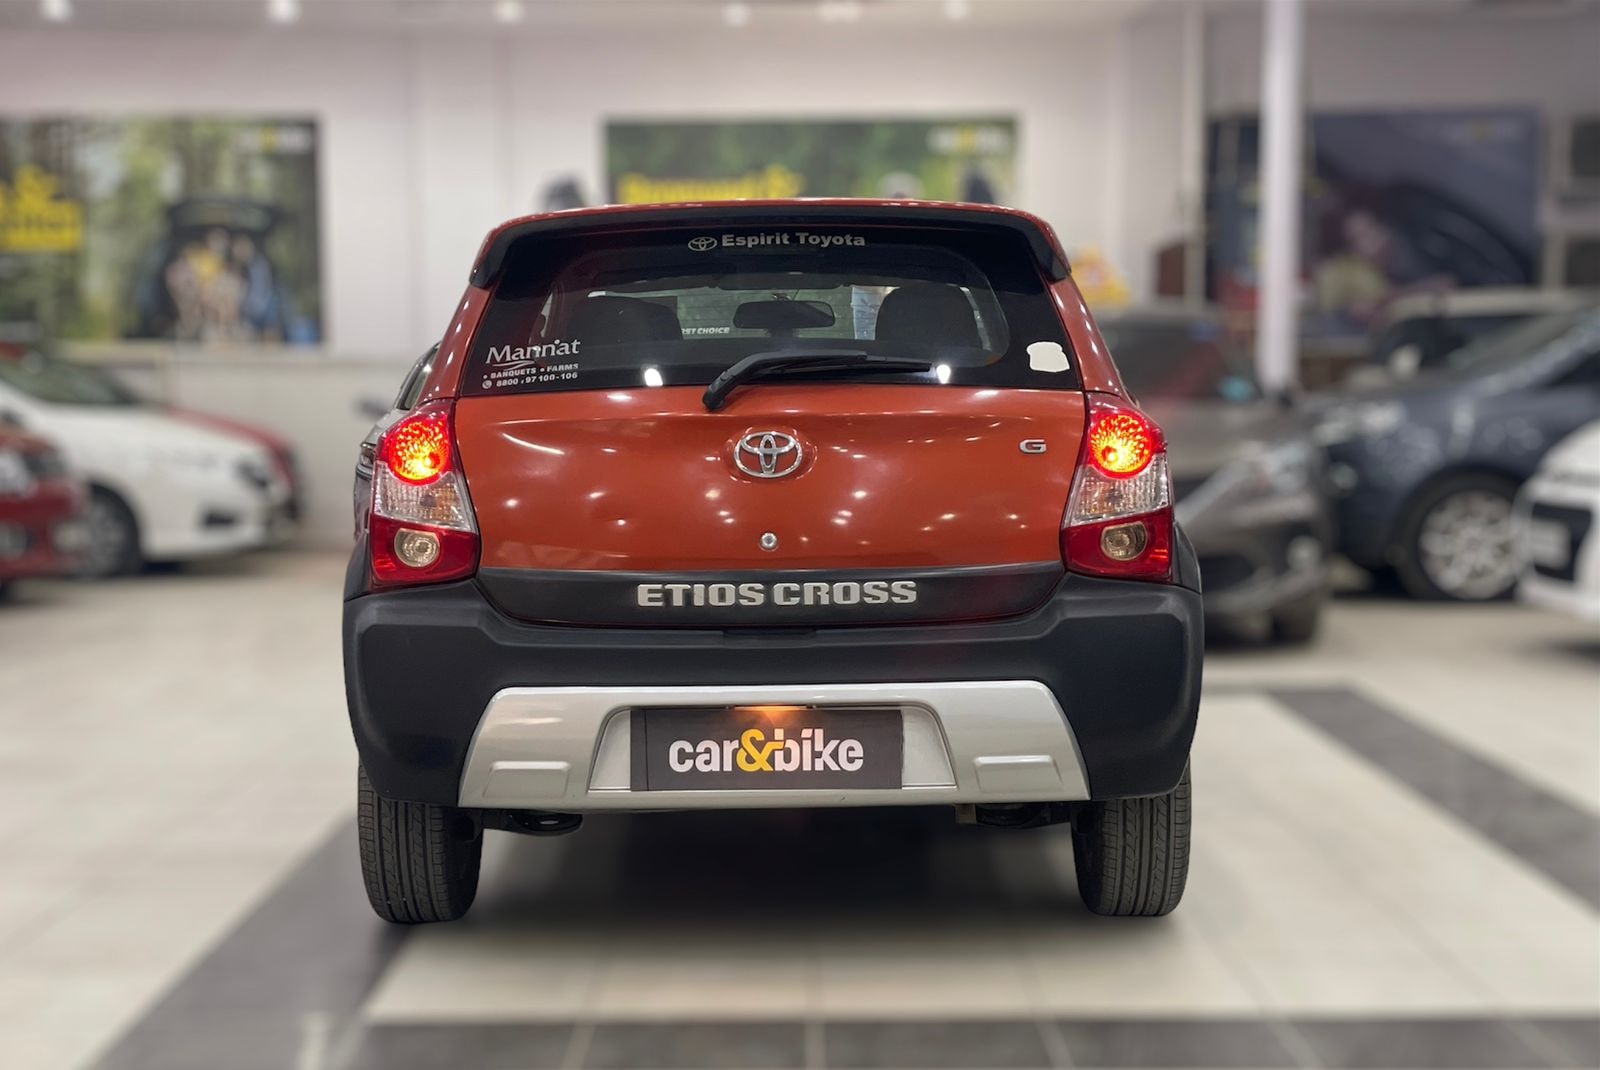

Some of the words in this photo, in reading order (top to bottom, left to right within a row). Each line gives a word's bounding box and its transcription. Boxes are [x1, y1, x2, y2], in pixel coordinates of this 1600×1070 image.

[721, 233, 789, 248] Espirit
[795, 232, 866, 248] Toyota
[490, 367, 536, 379] BANQUETS
[546, 363, 579, 372] FARMS
[496, 378, 519, 387] 8800
[1019, 439, 1047, 454] G
[637, 583, 765, 607] ETIOS
[773, 581, 917, 606] CROSS
[668, 728, 864, 773] car&bike
